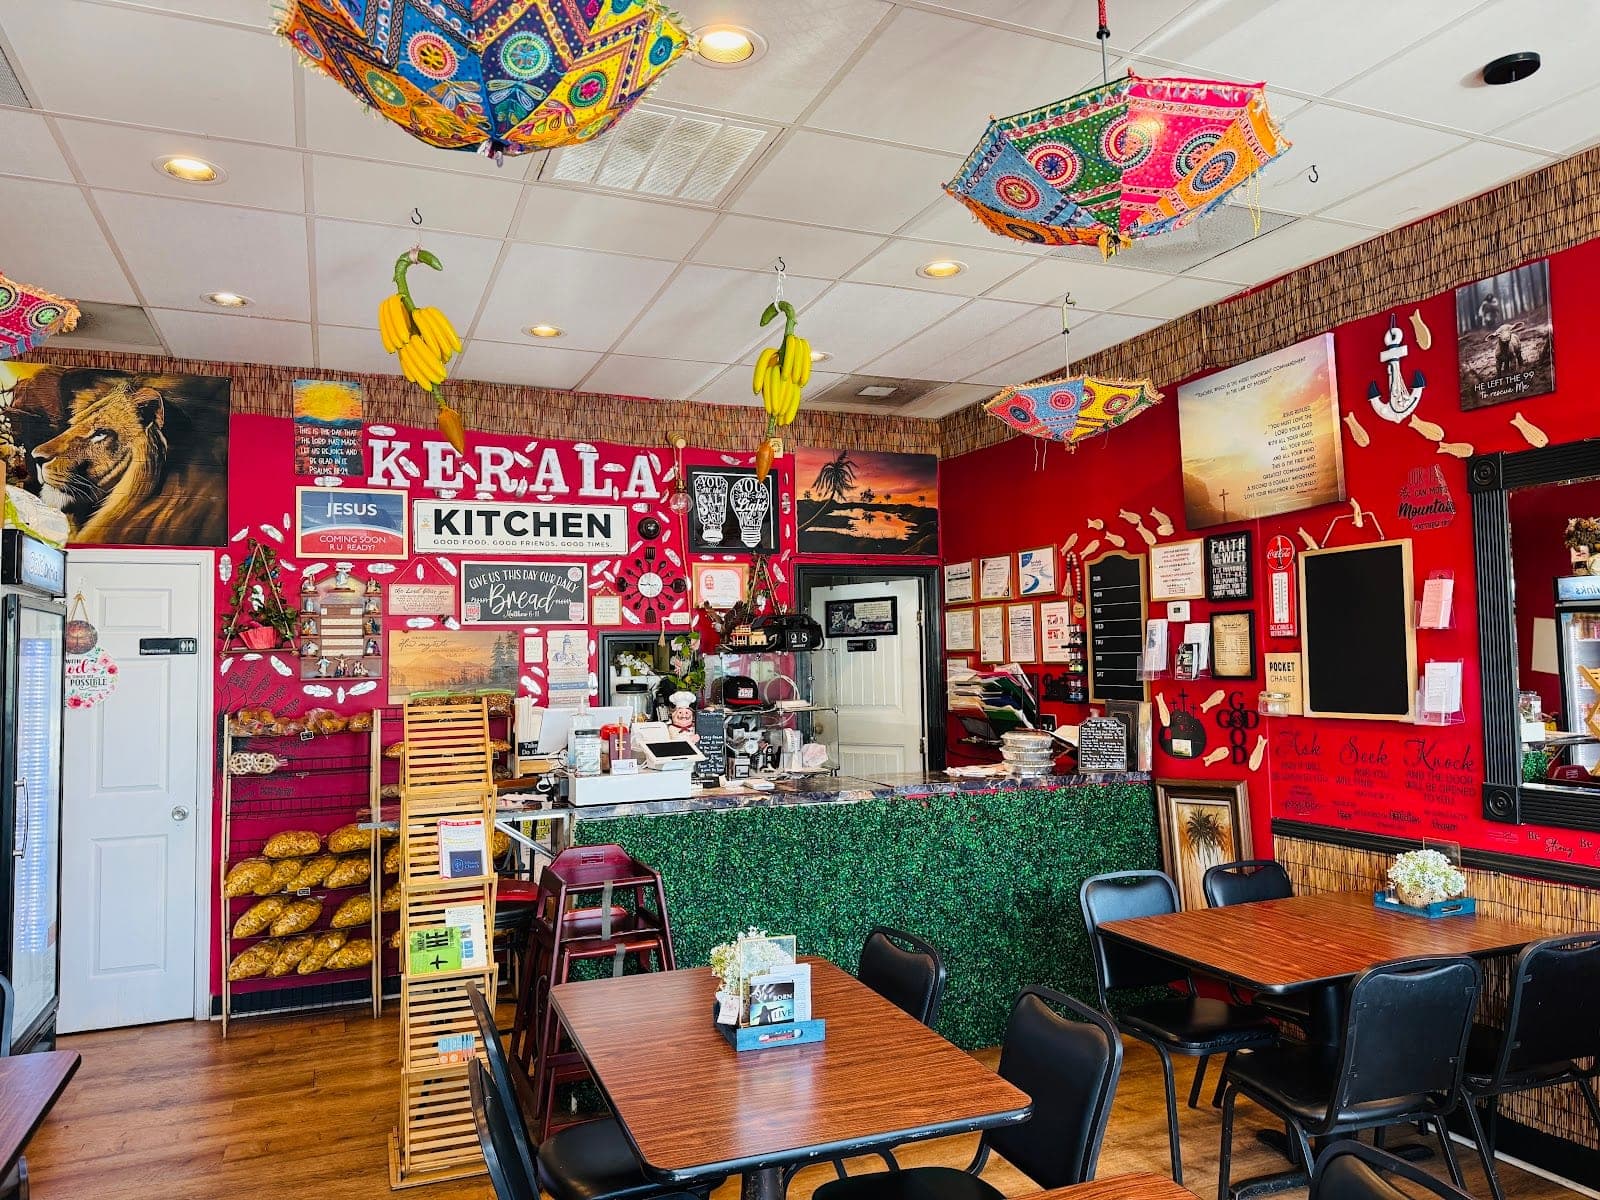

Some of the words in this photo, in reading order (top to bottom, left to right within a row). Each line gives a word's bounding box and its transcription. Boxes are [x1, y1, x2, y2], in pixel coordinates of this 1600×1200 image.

[1474, 383, 1486, 391] HE
[1487, 378, 1503, 388] LEFT
[1505, 374, 1521, 384] THE
[1523, 371, 1535, 380] 99
[299, 426, 312, 435] THIS
[344, 429, 358, 437] THAT
[301, 436, 311, 445] THE
[311, 437, 327, 445] LORD
[328, 438, 340, 446] HAS
[1286, 434, 1299, 442] YOUR
[1289, 441, 1301, 449] YOUR
[300, 447, 309, 455] LET
[311, 447, 320, 455] US
[321, 447, 344, 456] REJOICE
[1291, 449, 1303, 457] YOUR
[309, 457, 317, 465] BE
[318, 457, 333, 465] GLAD
[309, 465, 333, 474] PSALMS
[366, 438, 662, 499] KERALA
[701, 477, 720, 488] YOU
[738, 479, 762, 493] YOU
[699, 493, 726, 516] SALT
[736, 498, 767, 514] Light
[326, 502, 378, 519] JESUS
[433, 508, 612, 539] KITCHEN
[319, 535, 358, 543] COMING
[359, 536, 386, 544] SOON
[329, 543, 336, 551] R
[337, 543, 343, 551] U
[1211, 537, 1247, 554] FAITH
[469, 574, 489, 590] GIVE
[488, 570, 501, 583] US
[503, 569, 521, 581] THIS
[522, 569, 539, 581] DAY
[539, 571, 557, 585] OUR
[556, 576, 579, 593] DAILY
[488, 583, 558, 615] Bread
[1269, 661, 1295, 672] POCKET
[71, 678, 108, 688] POSSIBLE
[1338, 735, 1389, 767] Seek
[1402, 738, 1475, 772] Knock
[1446, 774, 1473, 784] DOOR
[773, 993, 793, 1001] BORN
[774, 1009, 793, 1019] LIVE
